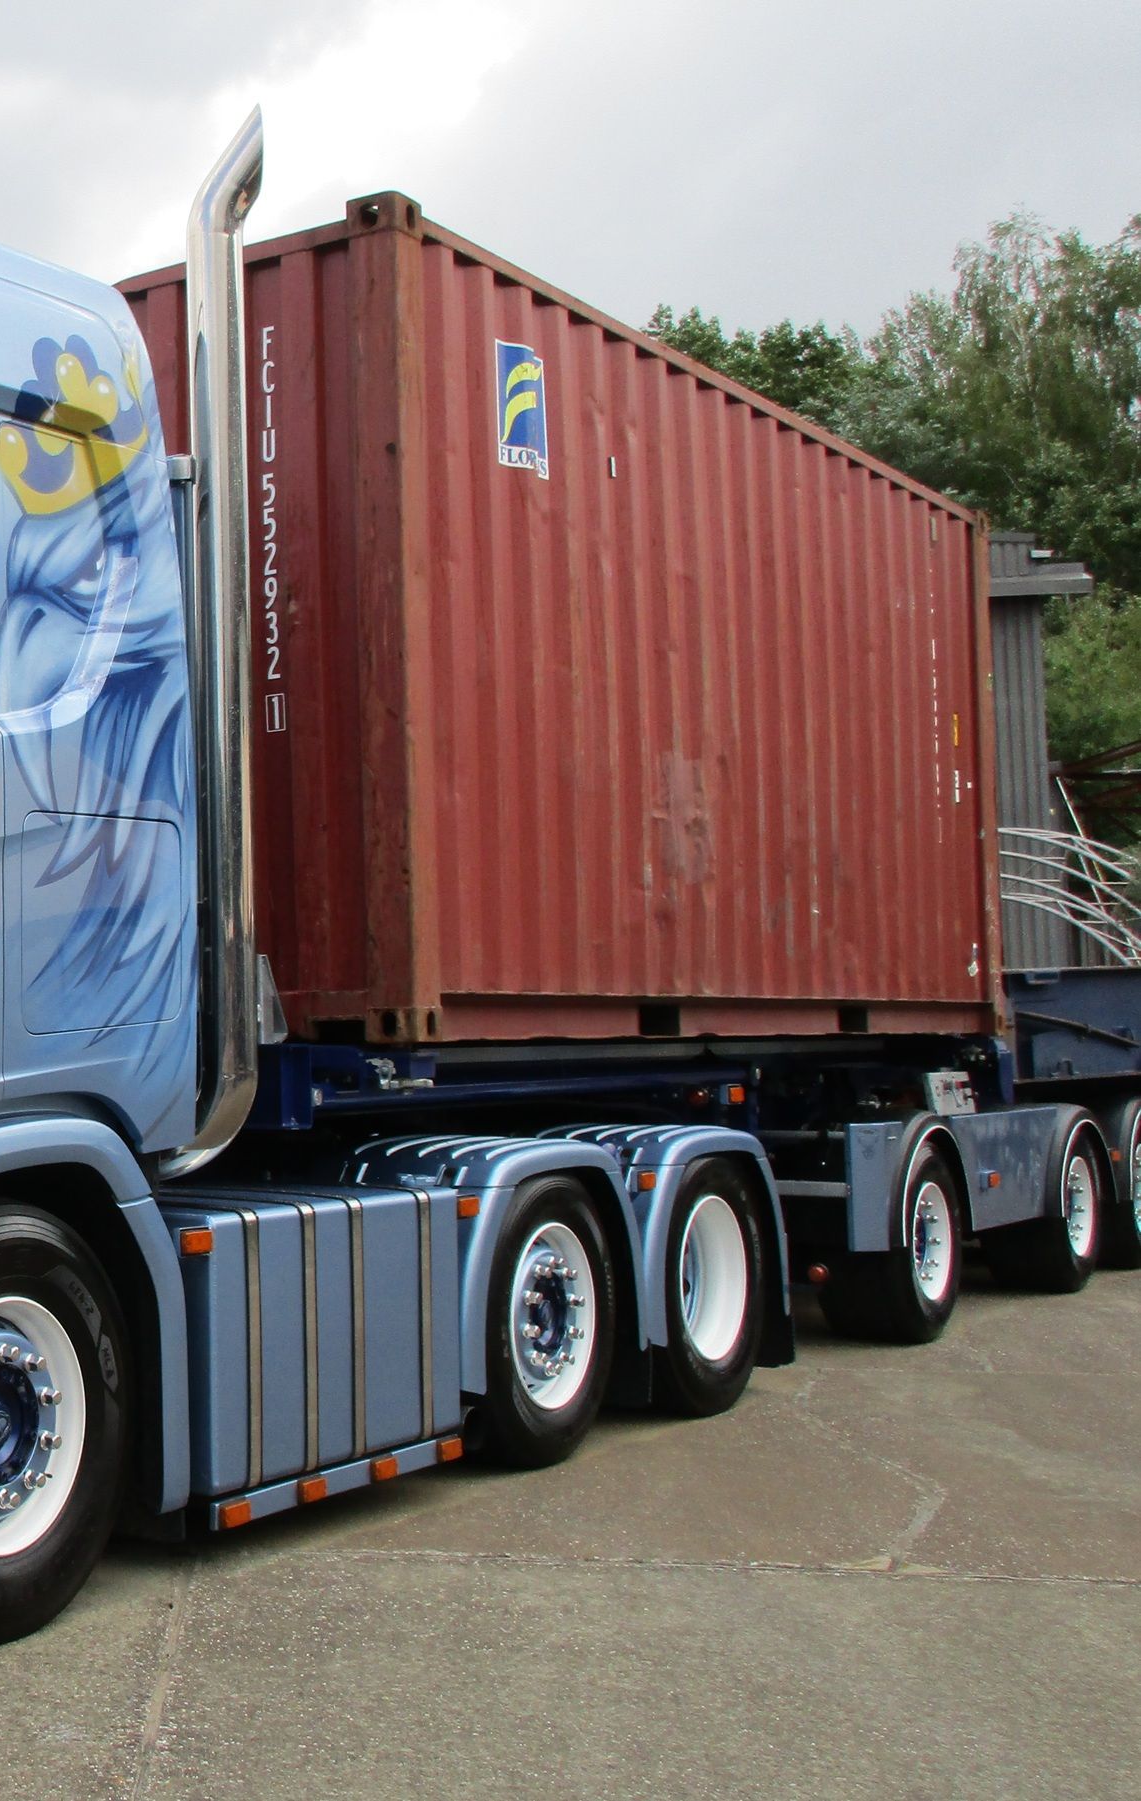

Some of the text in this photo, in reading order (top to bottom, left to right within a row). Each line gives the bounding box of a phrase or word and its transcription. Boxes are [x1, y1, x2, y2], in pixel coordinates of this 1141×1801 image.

[262, 326, 283, 731] FCIU 552932 1
[500, 446, 547, 476] FLORS
